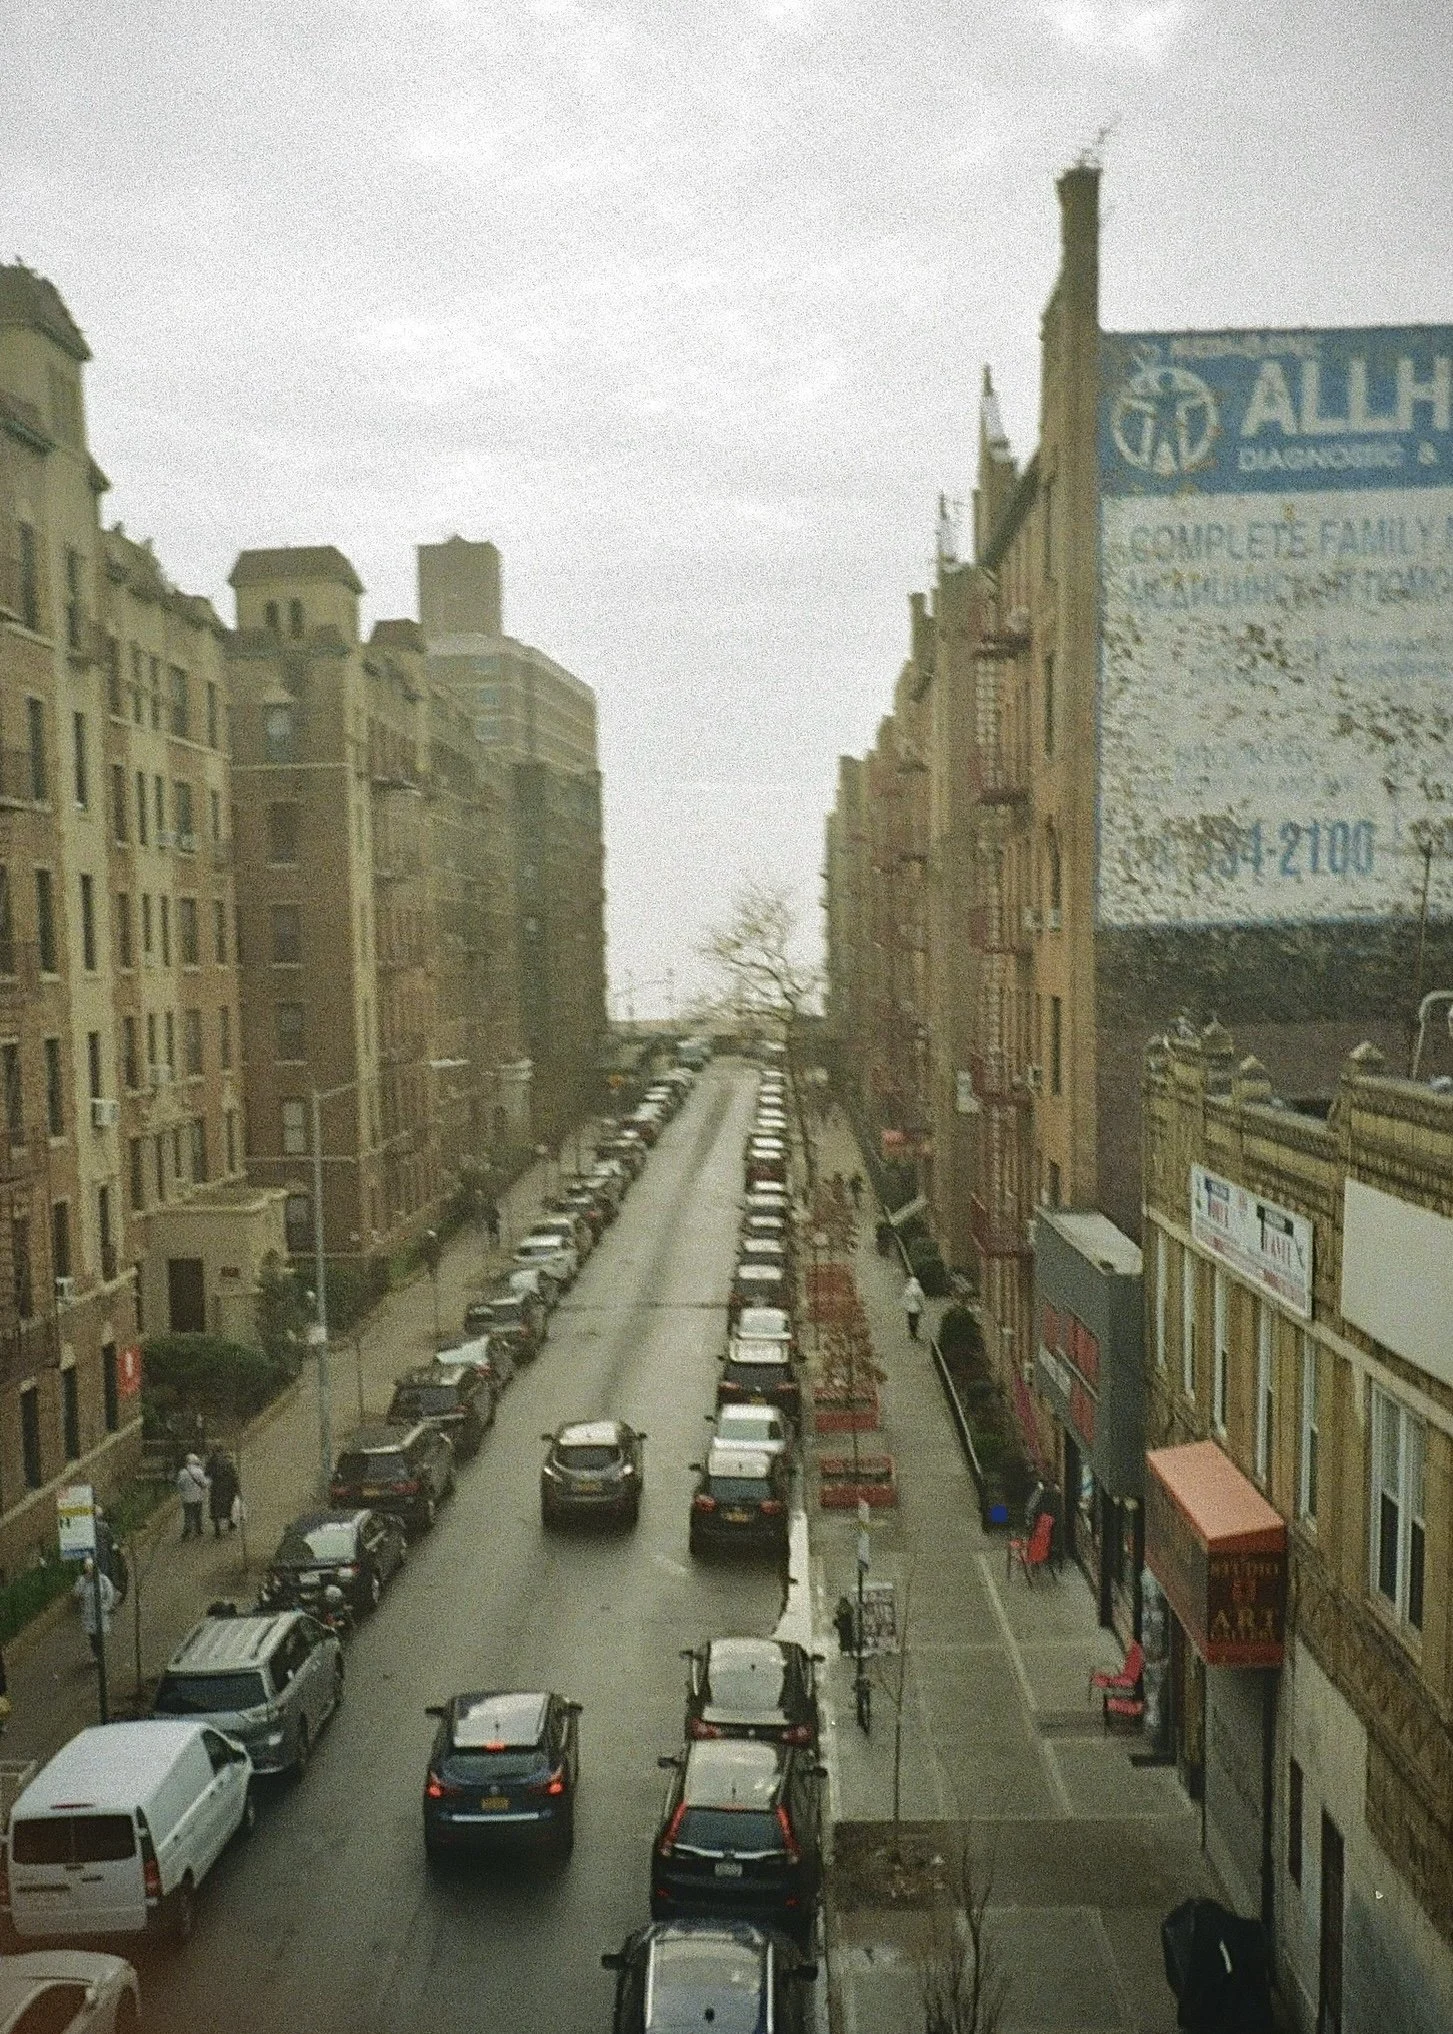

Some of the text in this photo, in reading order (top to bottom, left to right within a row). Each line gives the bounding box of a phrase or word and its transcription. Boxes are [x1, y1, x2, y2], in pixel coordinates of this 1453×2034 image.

[1241, 357, 1450, 436] ALLH
[1130, 516, 1435, 561] COMPLETE FAMILY
